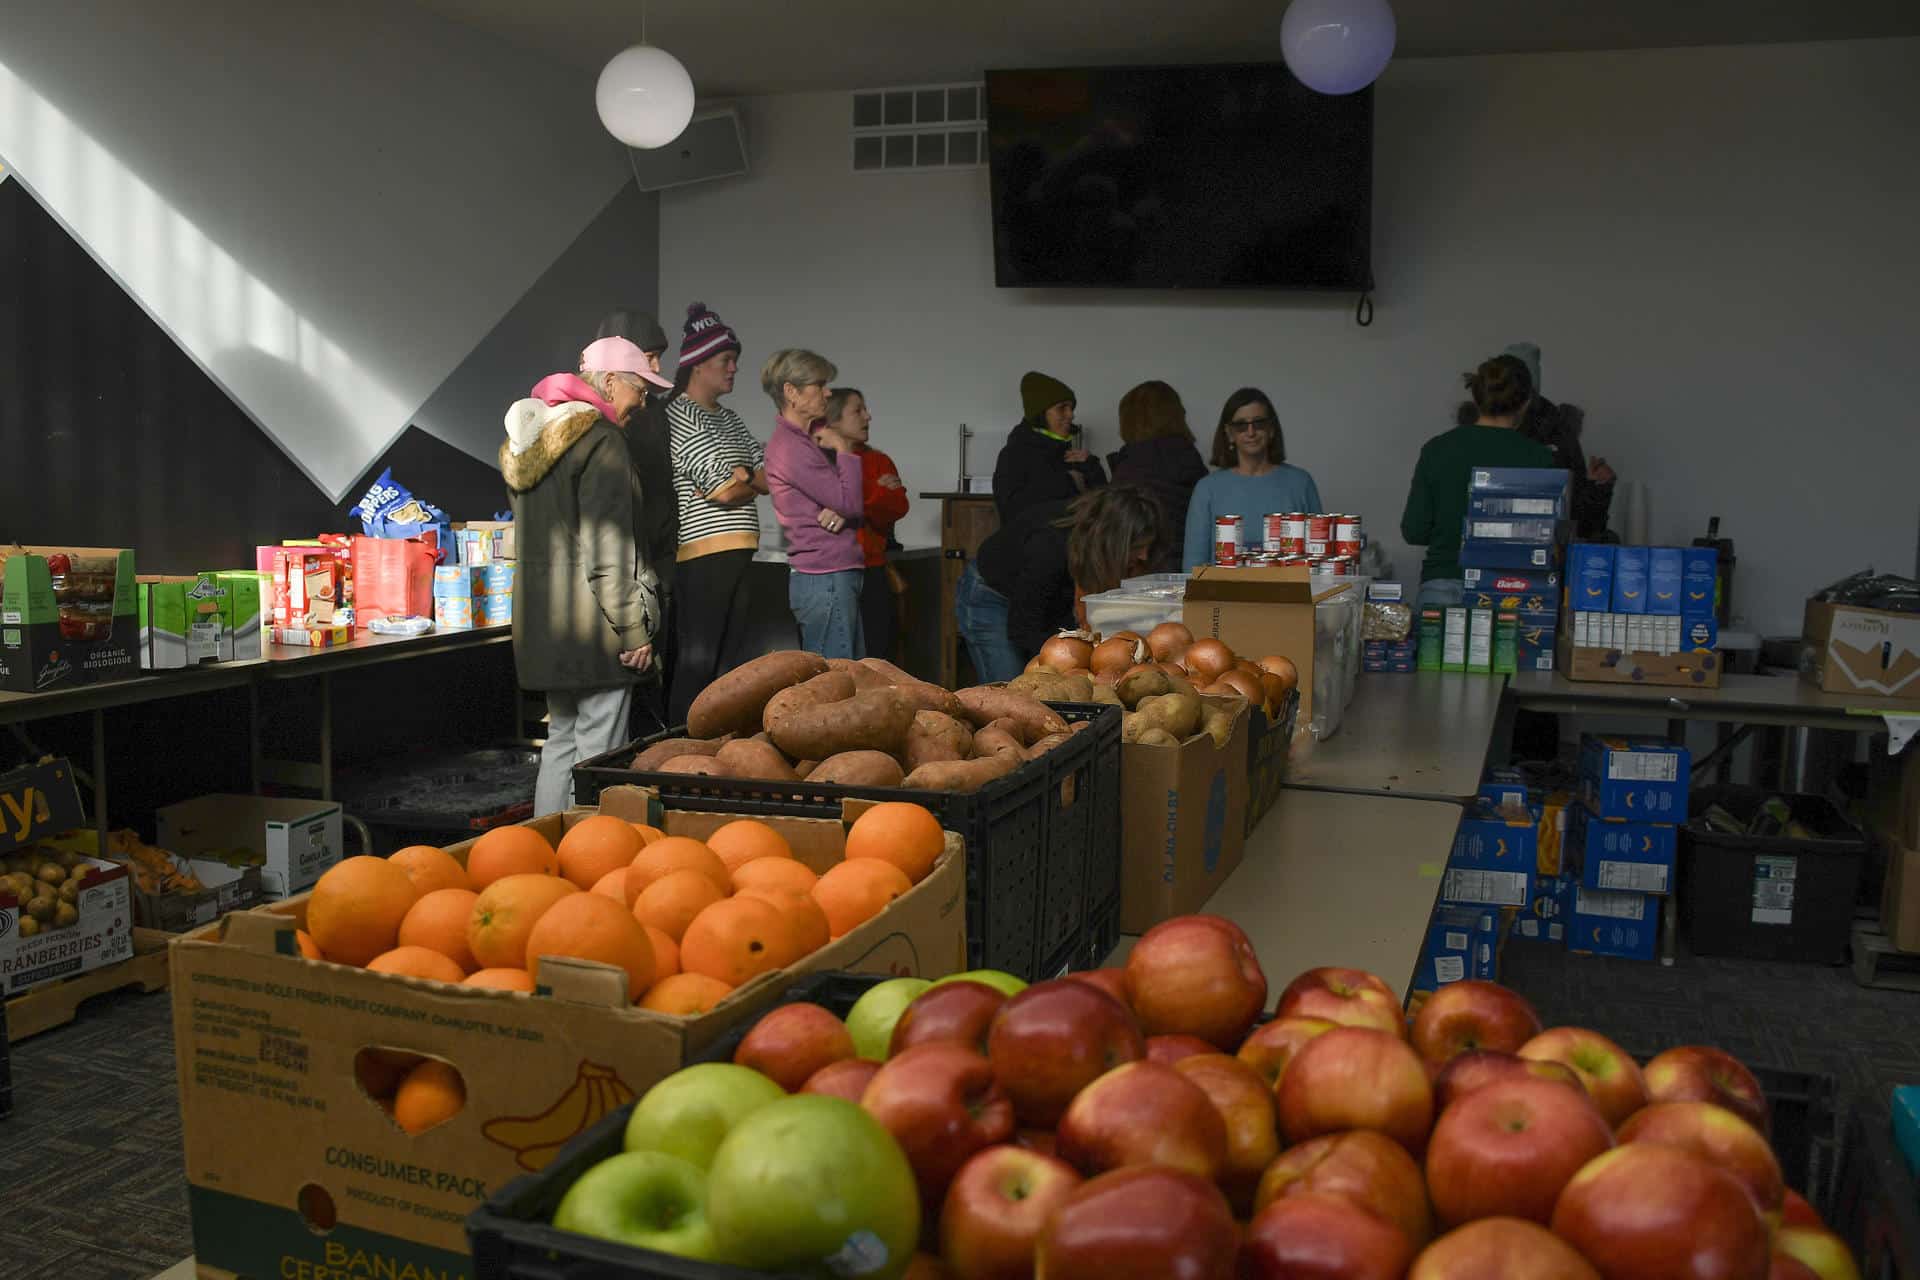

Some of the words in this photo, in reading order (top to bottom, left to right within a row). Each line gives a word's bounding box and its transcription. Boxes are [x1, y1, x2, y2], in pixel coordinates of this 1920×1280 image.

[359, 484, 383, 509] BIG
[361, 486, 399, 525] DIPPERS
[83, 655, 132, 670] BIOLOGIQUE
[90, 648, 126, 661] ORGANIC
[325, 1145, 433, 1190] CONSUMER
[435, 1170, 489, 1201] PACK
[345, 1186, 395, 1209] PRODUCT
